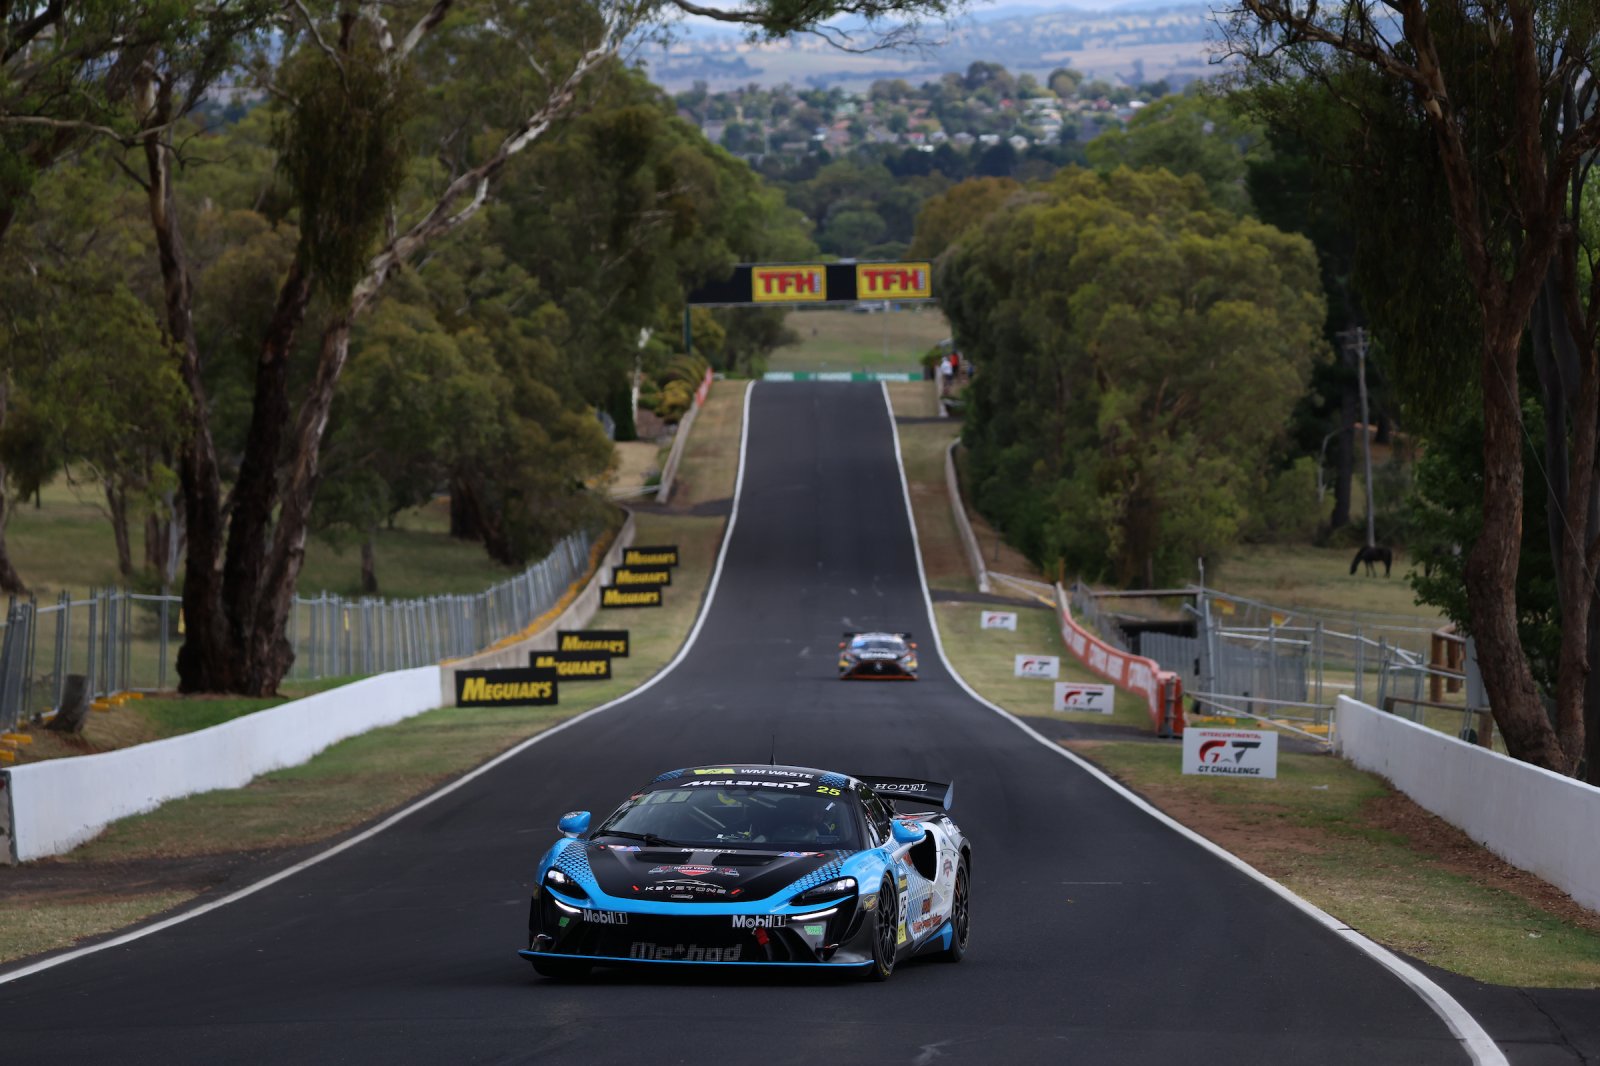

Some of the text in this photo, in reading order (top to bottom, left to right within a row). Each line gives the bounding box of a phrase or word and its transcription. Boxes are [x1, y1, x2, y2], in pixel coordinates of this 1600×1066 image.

[759, 272, 815, 293] TFH
[863, 270, 919, 291] TFH
[536, 656, 607, 676] MGUIAR'S
[462, 677, 553, 701] MEGUIAR'S
[768, 770, 815, 779] WASTE
[1198, 765, 1261, 775] GT CHALLENGE
[816, 786, 841, 796] 25
[874, 783, 928, 792] HOTEL
[645, 885, 726, 894] KEYSTONE
[583, 909, 614, 924] Mobil
[732, 914, 772, 928] Mobil
